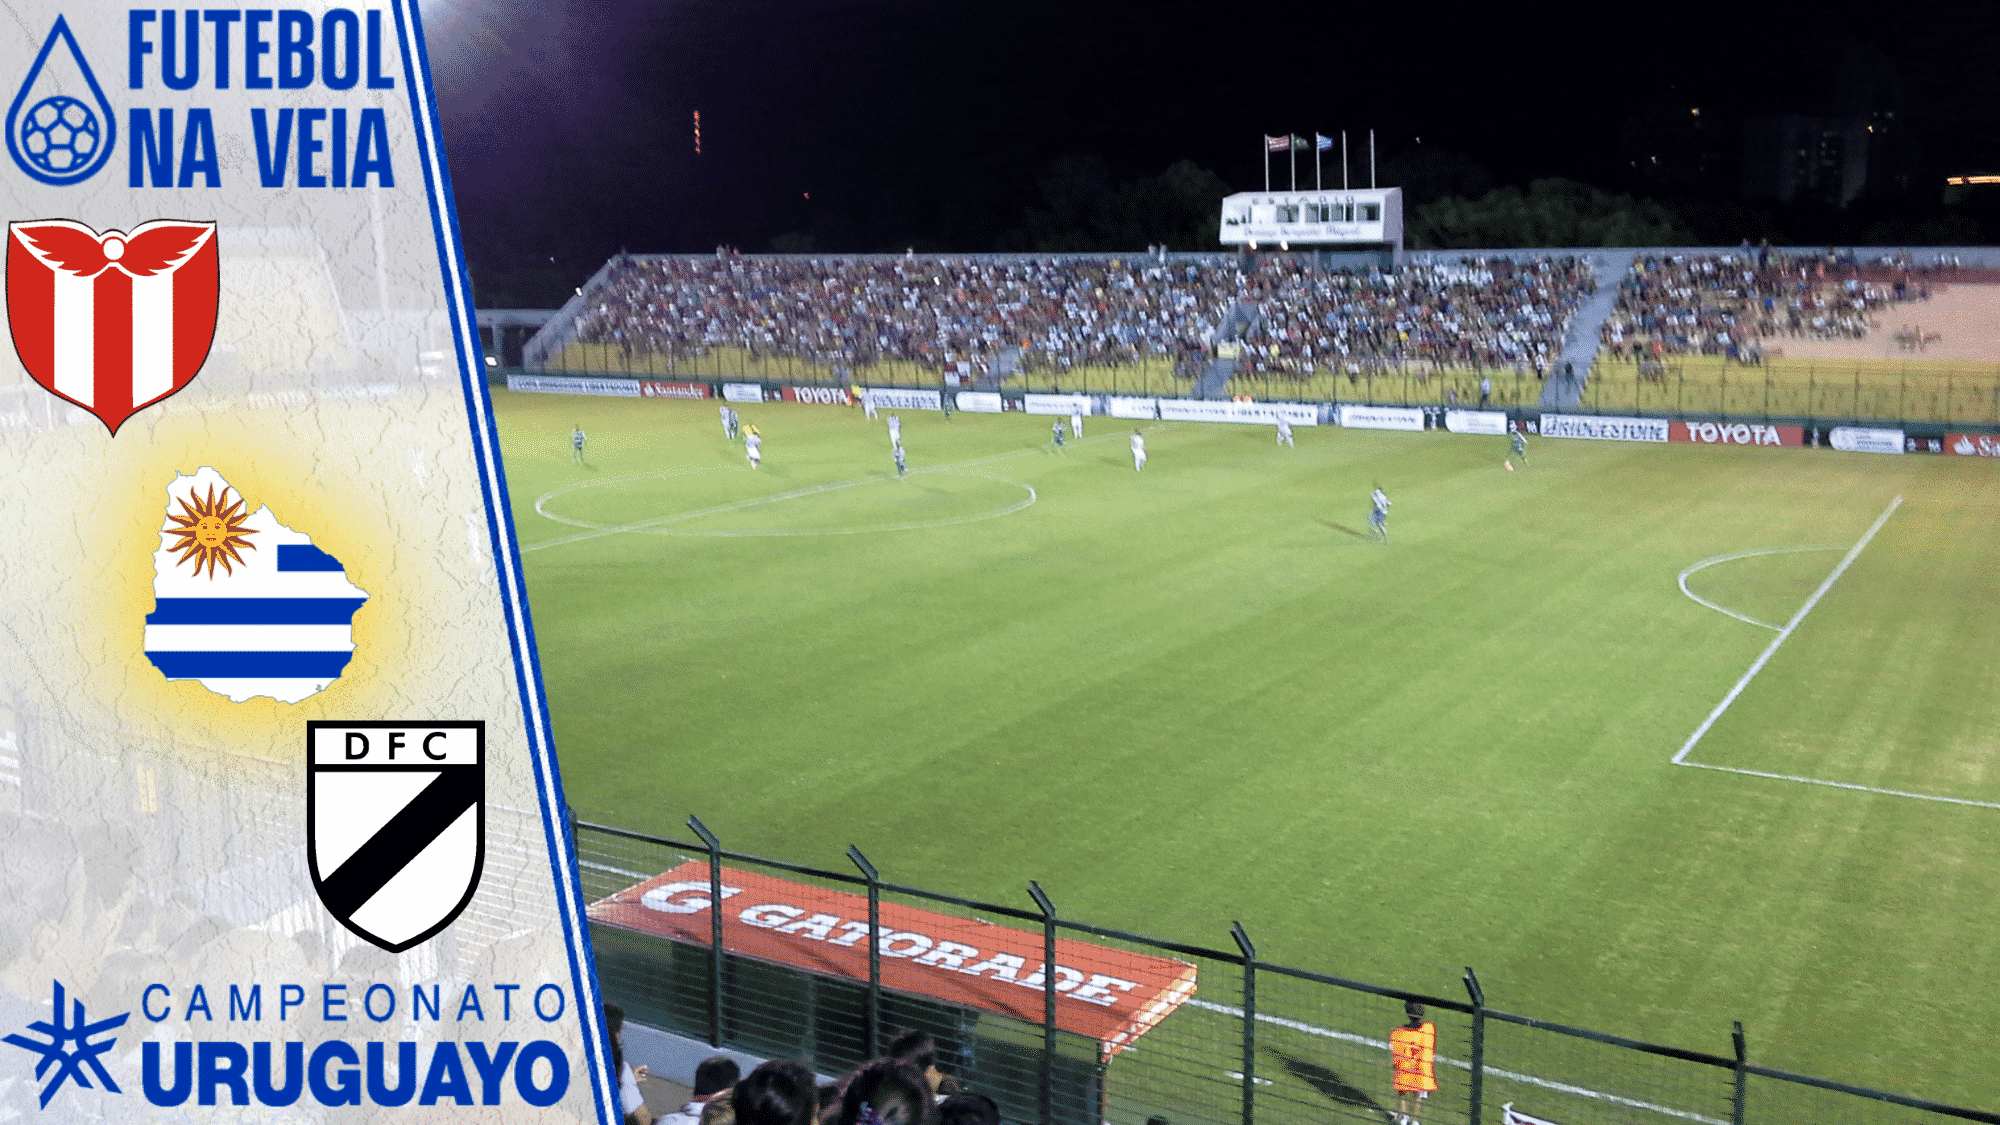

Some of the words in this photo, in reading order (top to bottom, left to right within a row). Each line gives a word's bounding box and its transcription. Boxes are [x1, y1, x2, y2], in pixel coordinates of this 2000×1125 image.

[793, 386, 849, 404] TOYOTA
[1686, 421, 1781, 446] TOYOTA
[641, 881, 743, 913] G
[738, 904, 1138, 1006] GATORADE
